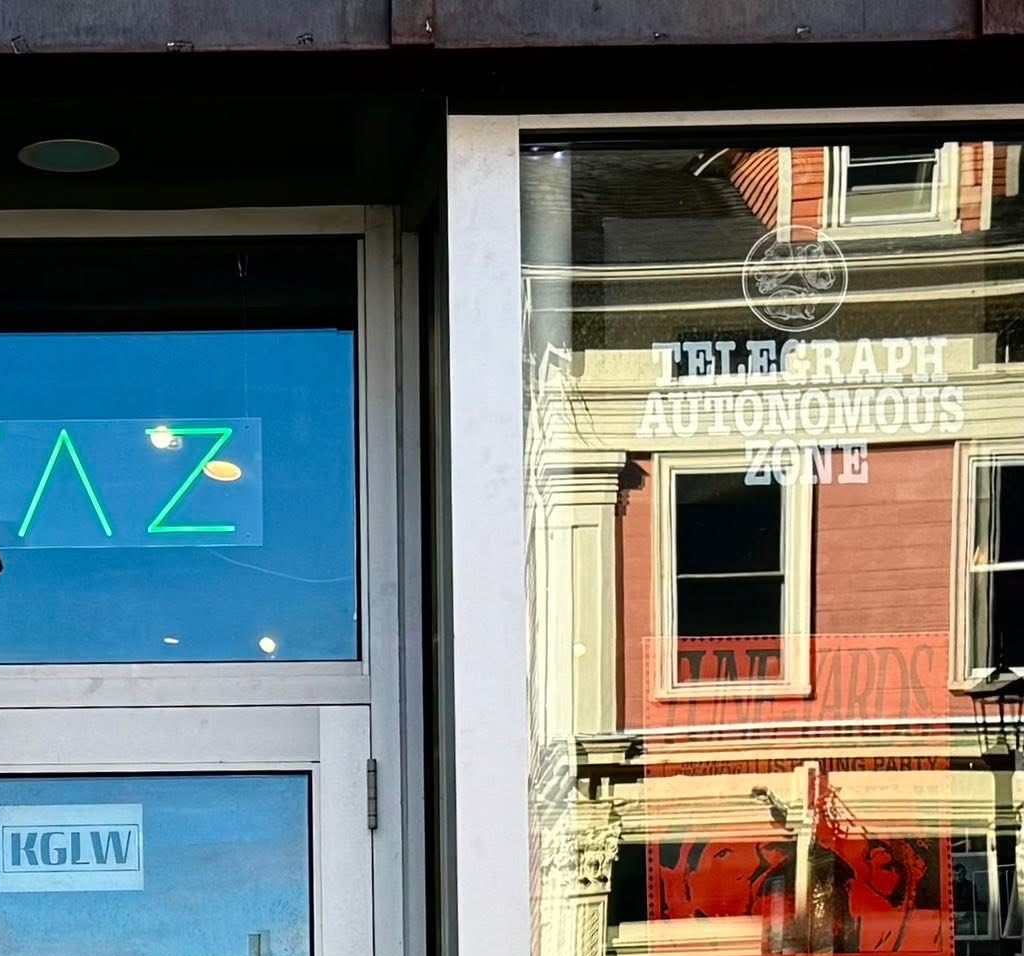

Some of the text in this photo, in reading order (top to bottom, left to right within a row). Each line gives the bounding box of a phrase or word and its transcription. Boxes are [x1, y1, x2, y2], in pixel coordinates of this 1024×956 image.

[652, 337, 948, 386] TELEGRAPH
[636, 386, 965, 438] AUTONOMOUS
[744, 438, 869, 486] ZONE
[875, 757, 938, 772] PARTY
[11, 829, 133, 867] KGLW
